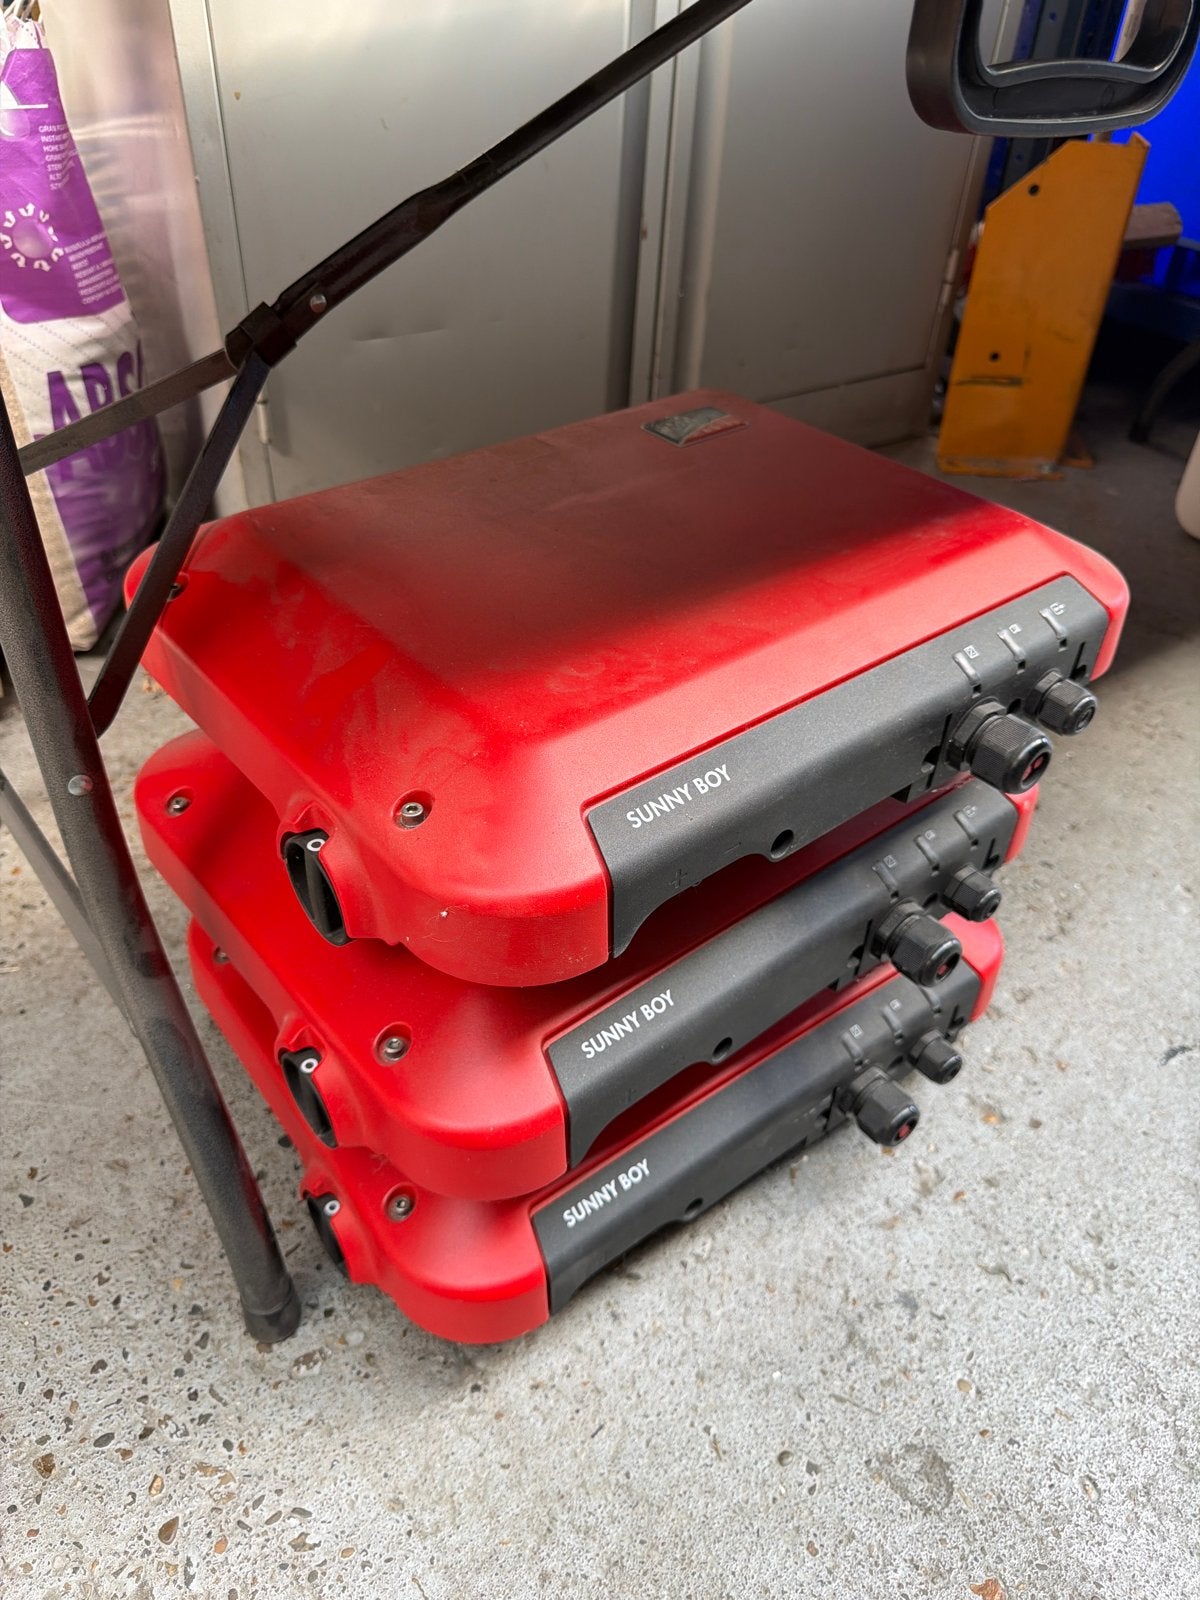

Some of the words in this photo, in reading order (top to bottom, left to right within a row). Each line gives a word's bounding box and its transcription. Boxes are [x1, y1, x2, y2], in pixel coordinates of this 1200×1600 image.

[626, 783, 693, 829] SUNNY
[692, 763, 731, 794] BOY
[581, 1010, 640, 1059] SUNNY
[639, 989, 674, 1021] BOY
[562, 1179, 618, 1229] SUNNY
[617, 1158, 650, 1191] BOY
